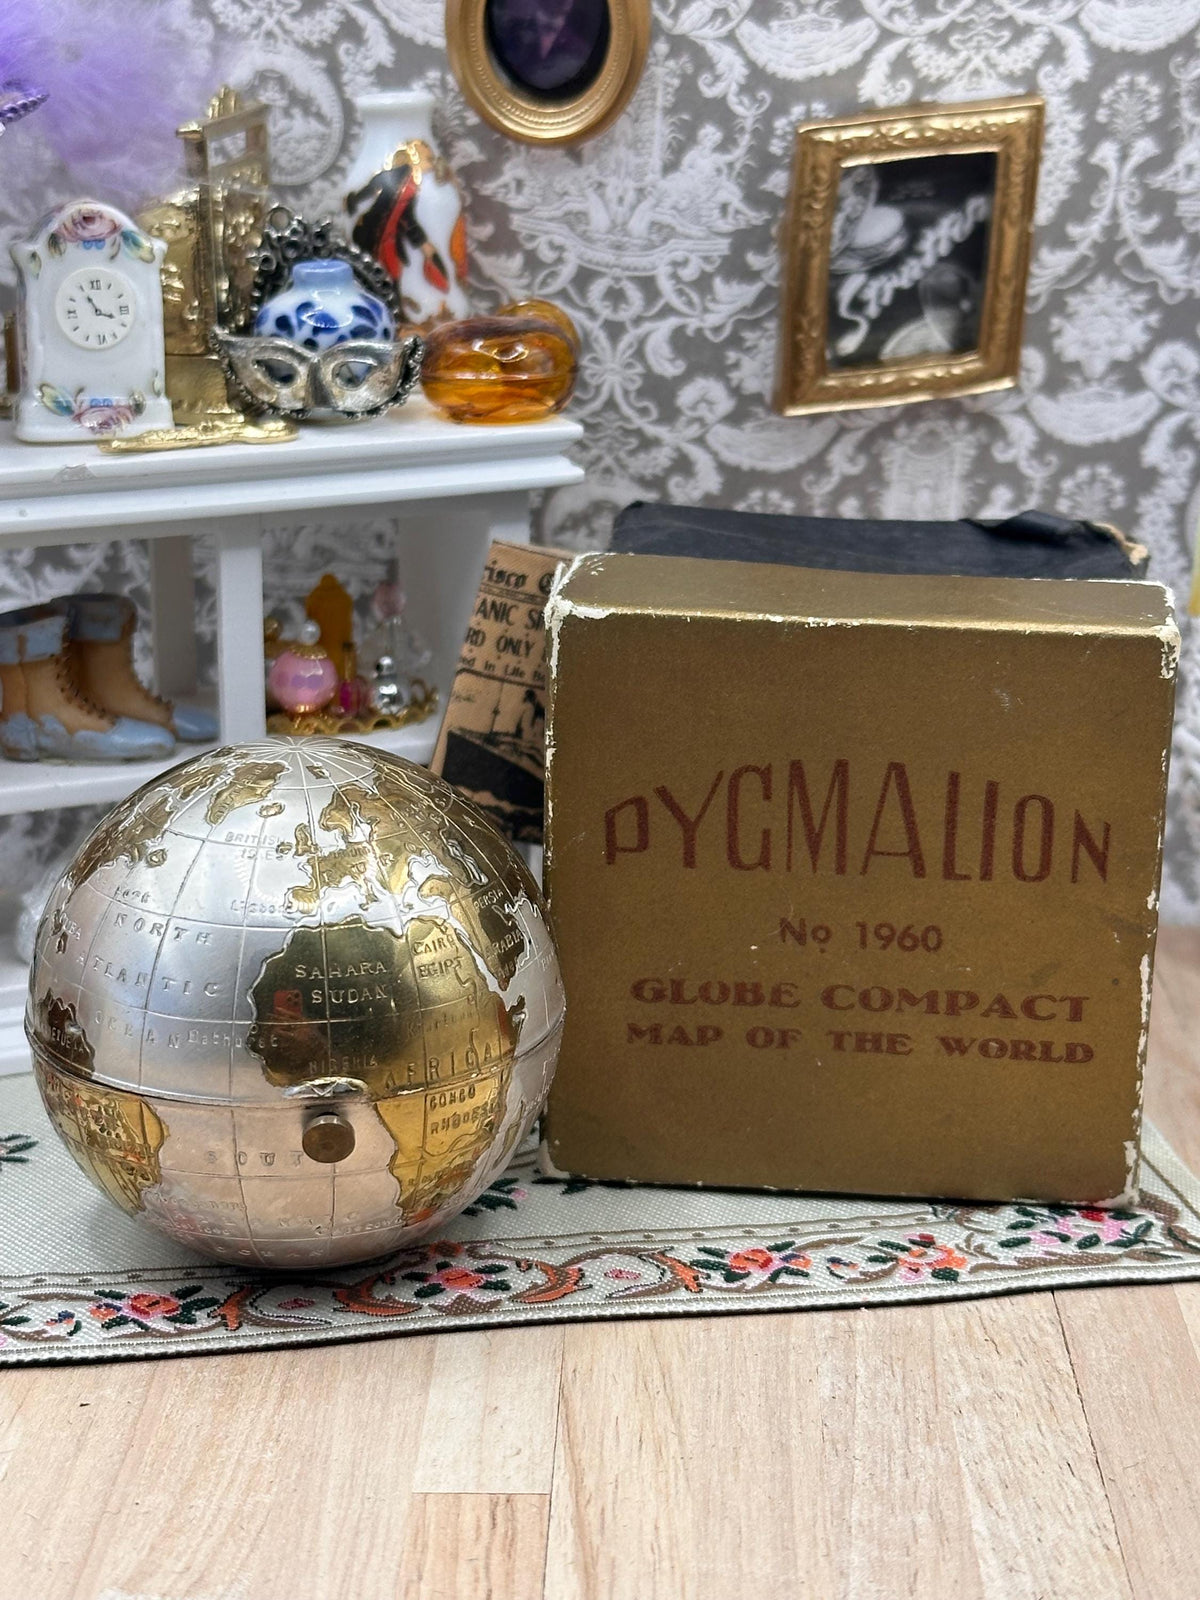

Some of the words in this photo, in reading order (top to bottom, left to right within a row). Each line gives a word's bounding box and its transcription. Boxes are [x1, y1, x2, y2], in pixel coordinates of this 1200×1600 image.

[604, 758, 1112, 884] PYGMALION
[114, 912, 213, 947] NORTH
[855, 920, 944, 954] 1960
[294, 961, 388, 980] SAHARA
[311, 984, 389, 1005] SUDAN
[630, 976, 800, 1009] GLOBE
[820, 983, 1091, 1023] COMPACT
[626, 1022, 723, 1048] MAP
[745, 1025, 800, 1050] OF
[829, 1030, 914, 1056] THE
[937, 1034, 1096, 1065] WORLD
[384, 1042, 496, 1091] AFRICA
[429, 1084, 477, 1111] CONGO
